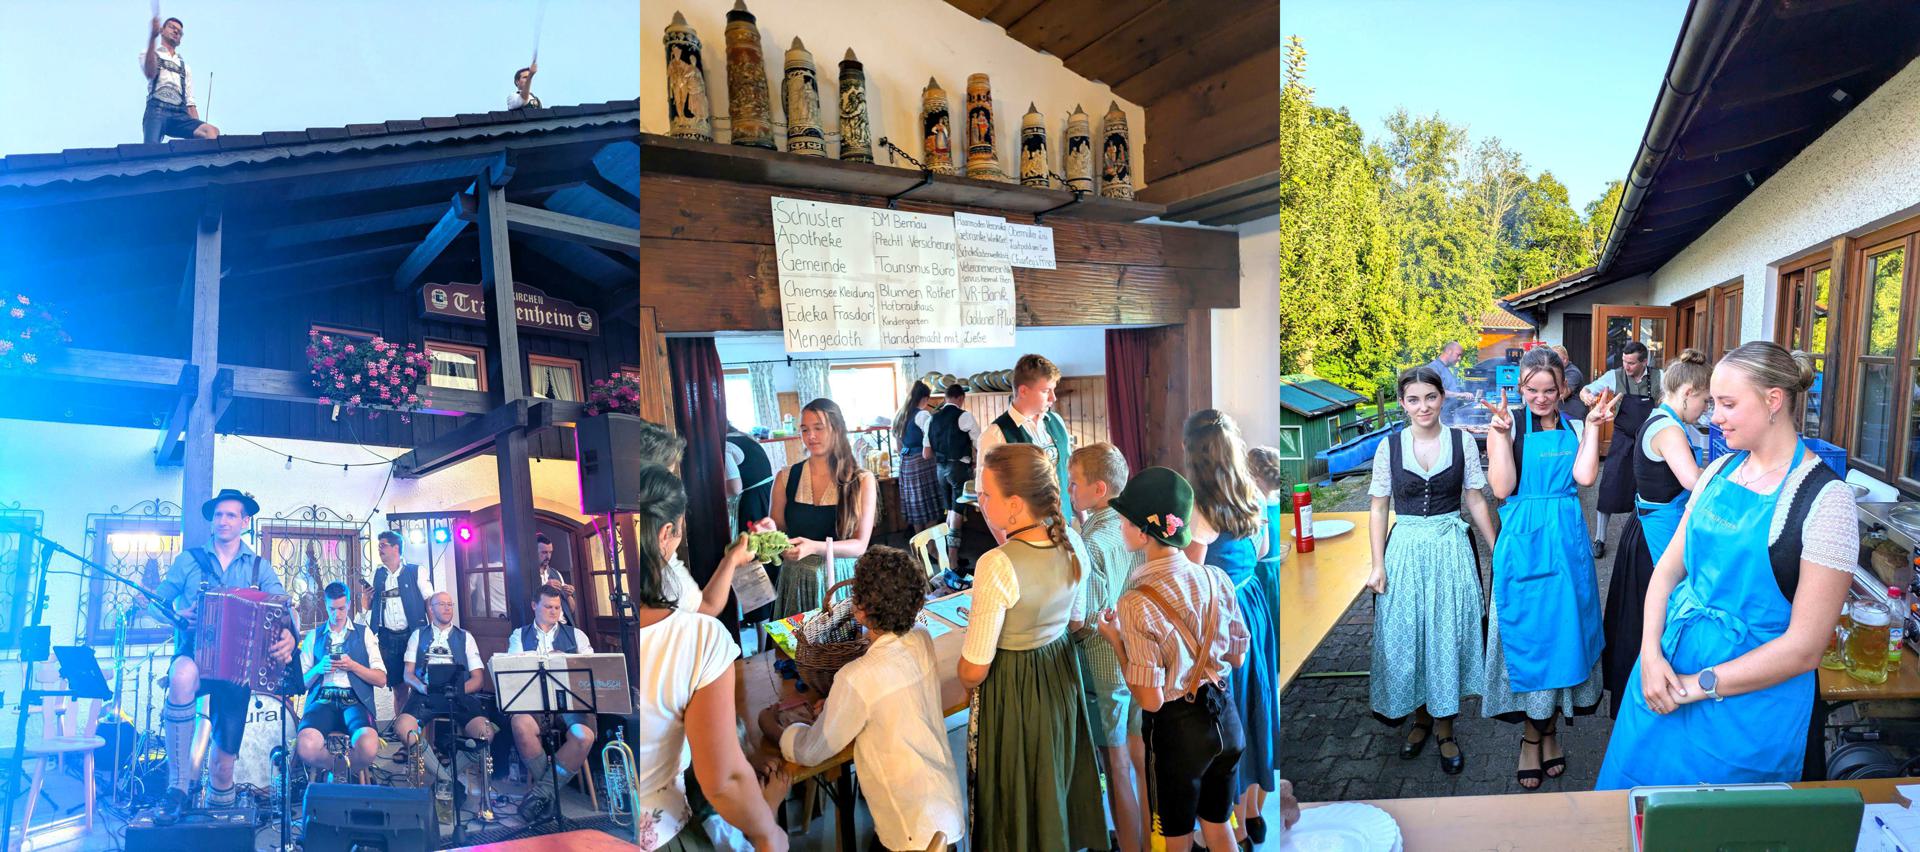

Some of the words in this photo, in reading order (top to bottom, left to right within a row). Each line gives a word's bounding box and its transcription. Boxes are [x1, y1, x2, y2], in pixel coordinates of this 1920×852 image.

[777, 201, 845, 228] Schuster
[873, 212, 890, 226] DM
[893, 214, 927, 230] Bernau
[778, 225, 842, 253] Apotheke
[875, 232, 903, 247] Prechtl
[909, 236, 956, 259] Versicherung
[782, 249, 847, 273] Gemeinde
[784, 280, 837, 298] Chiemsee
[840, 286, 875, 307] Kleidung
[880, 283, 922, 299] Blumen
[926, 285, 956, 299] Rother
[963, 285, 1008, 302] VR-Bank
[786, 303, 828, 323] Edeka
[833, 305, 876, 325] Frasdorf
[881, 314, 929, 329] Kindergarten
[997, 308, 1015, 335] Pflug
[789, 328, 863, 350] Mengedoth
[882, 329, 941, 350] Handgemacht
[944, 332, 959, 344] mit
